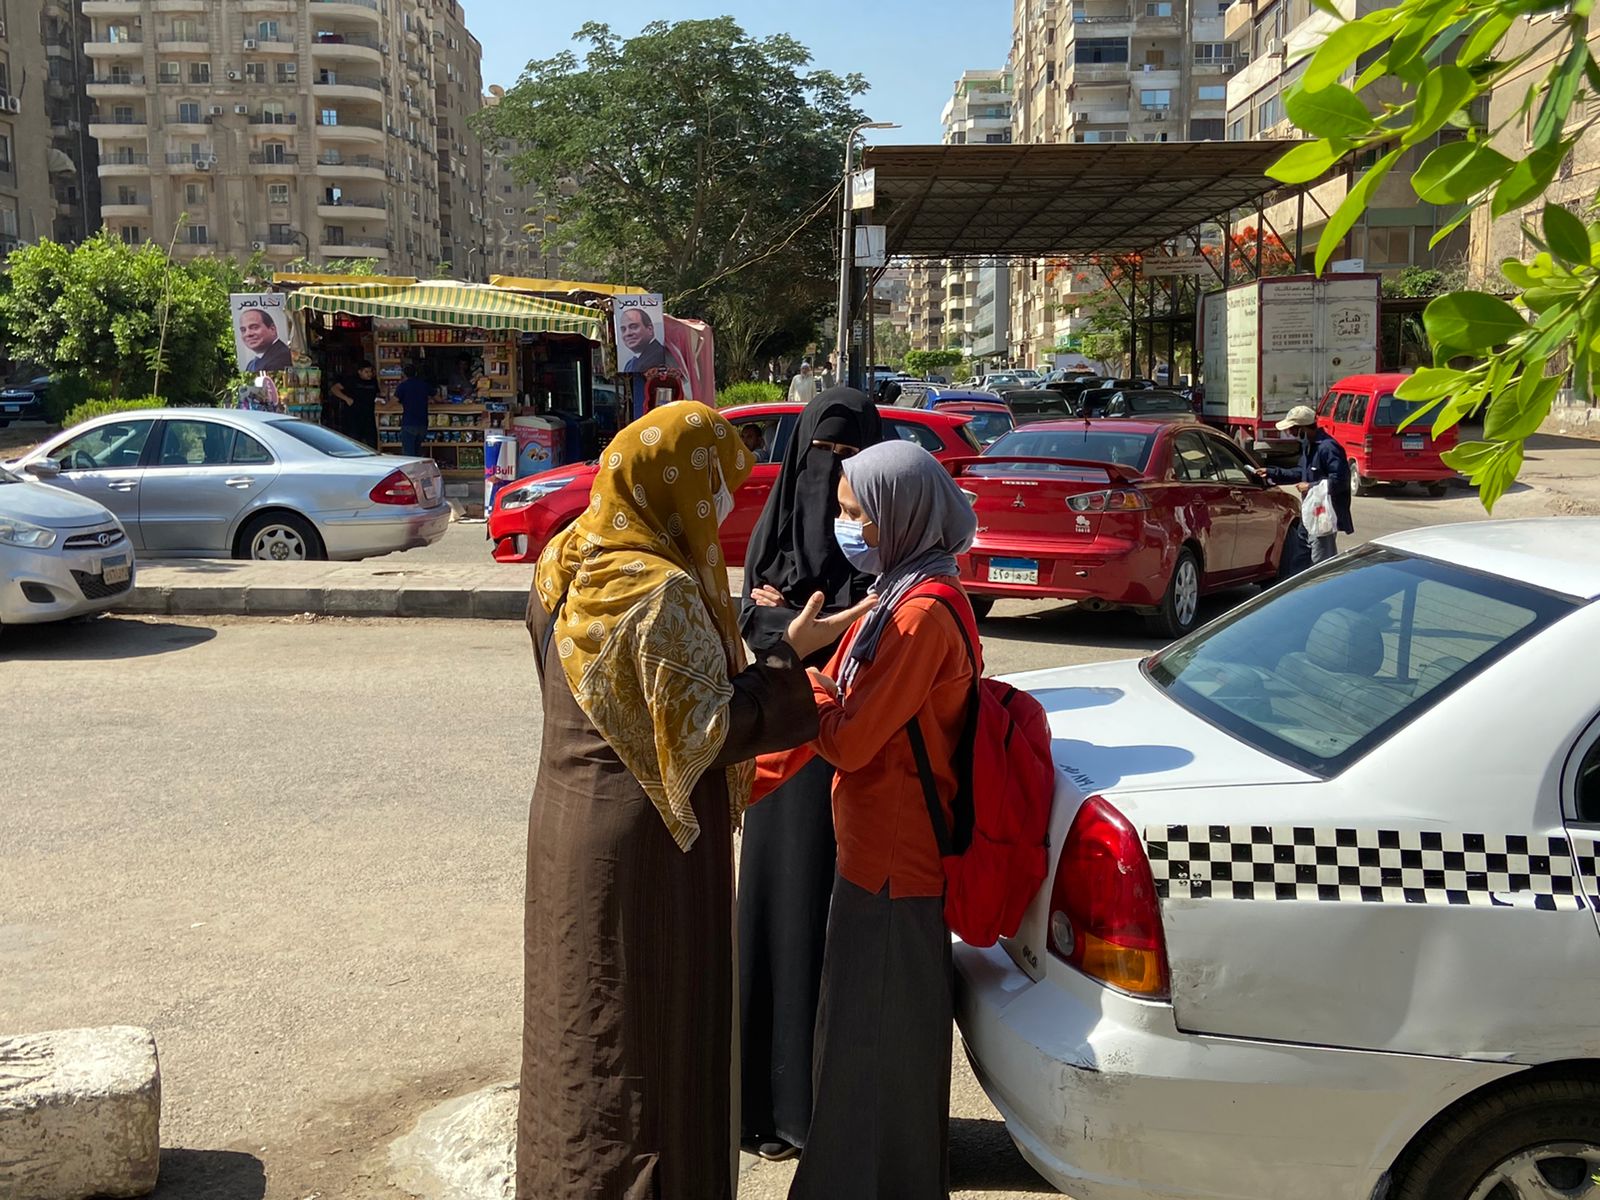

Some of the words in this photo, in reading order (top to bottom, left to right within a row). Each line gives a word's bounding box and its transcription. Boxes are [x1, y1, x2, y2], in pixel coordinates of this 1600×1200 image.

[237, 300, 258, 310] مصر
[259, 295, 280, 309] تحيا
[619, 299, 638, 309] مصر
[639, 295, 658, 309] تحيا
[495, 466, 513, 475] Bull
